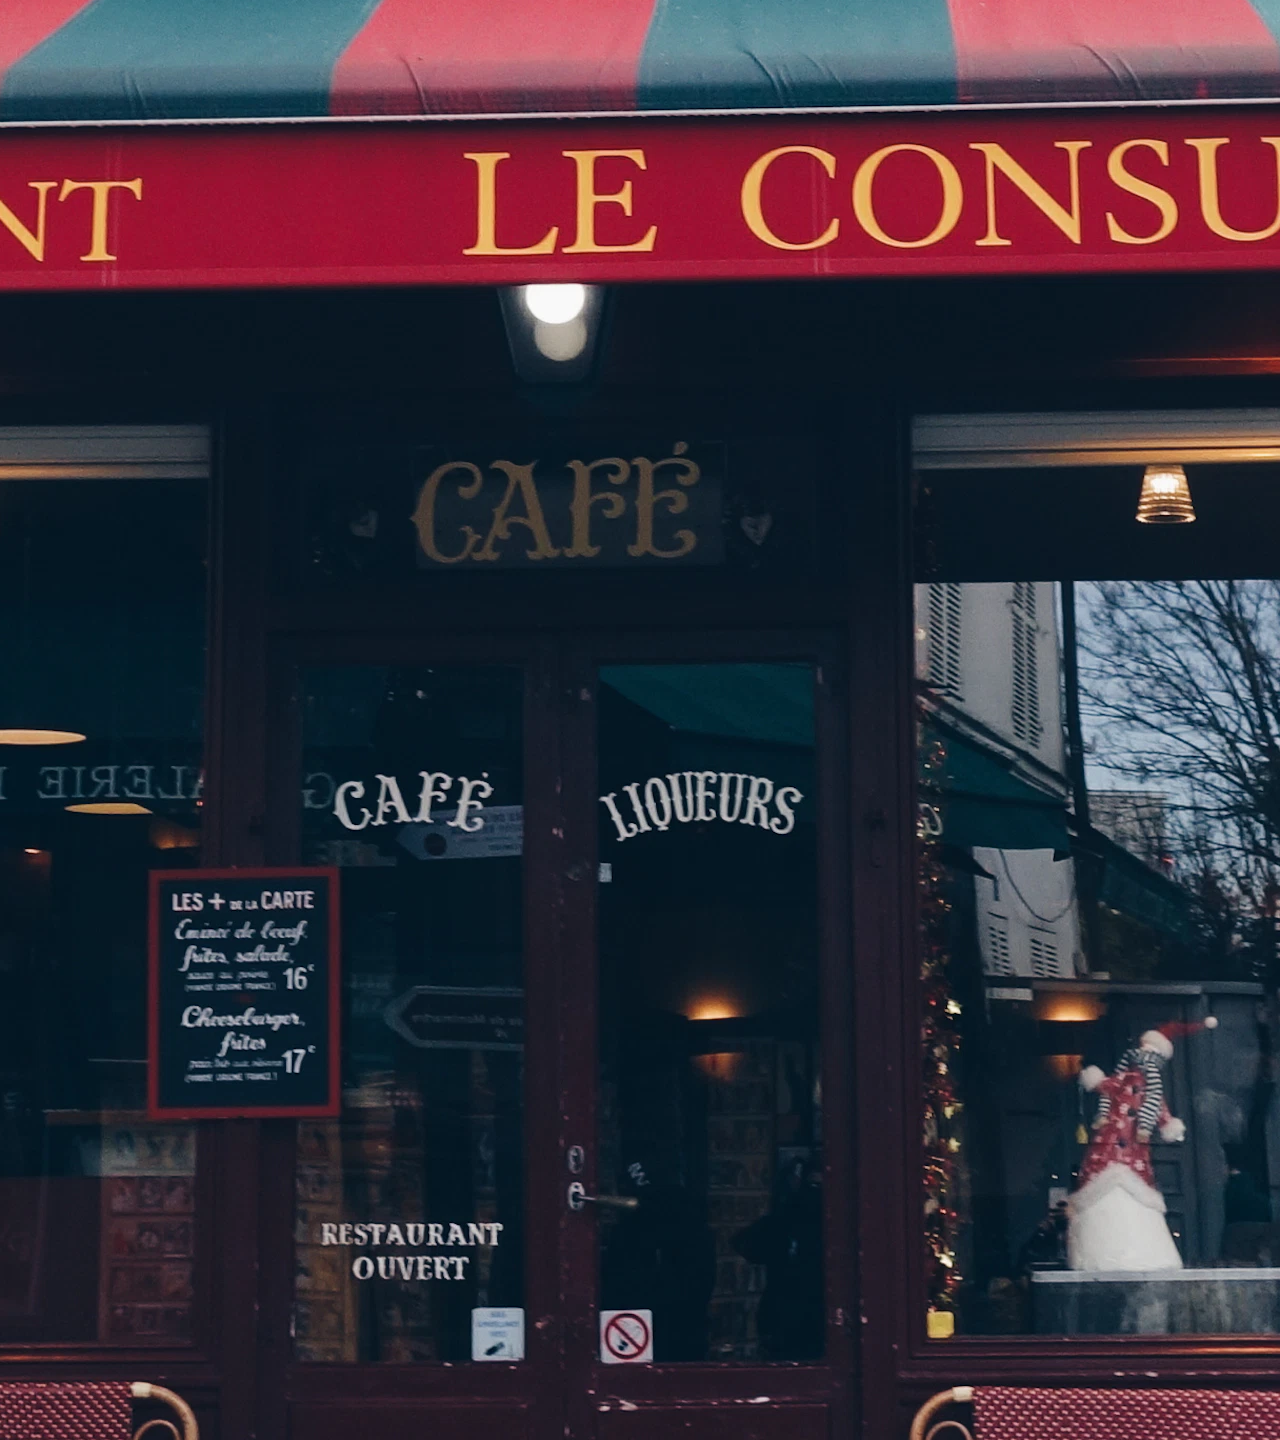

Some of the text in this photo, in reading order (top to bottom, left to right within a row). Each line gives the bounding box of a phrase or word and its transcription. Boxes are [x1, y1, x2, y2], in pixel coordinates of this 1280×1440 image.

[462, 148, 657, 256] LE
[409, 440, 701, 563] CAFÉ
[333, 770, 495, 832] CAFÉ
[600, 769, 804, 842] LIQUEURS
[172, 892, 204, 911] LES
[208, 892, 225, 911] +
[261, 890, 315, 910] CARTE
[320, 1221, 504, 1247] RESTAURANT
[352, 1255, 470, 1281] OUVERT
